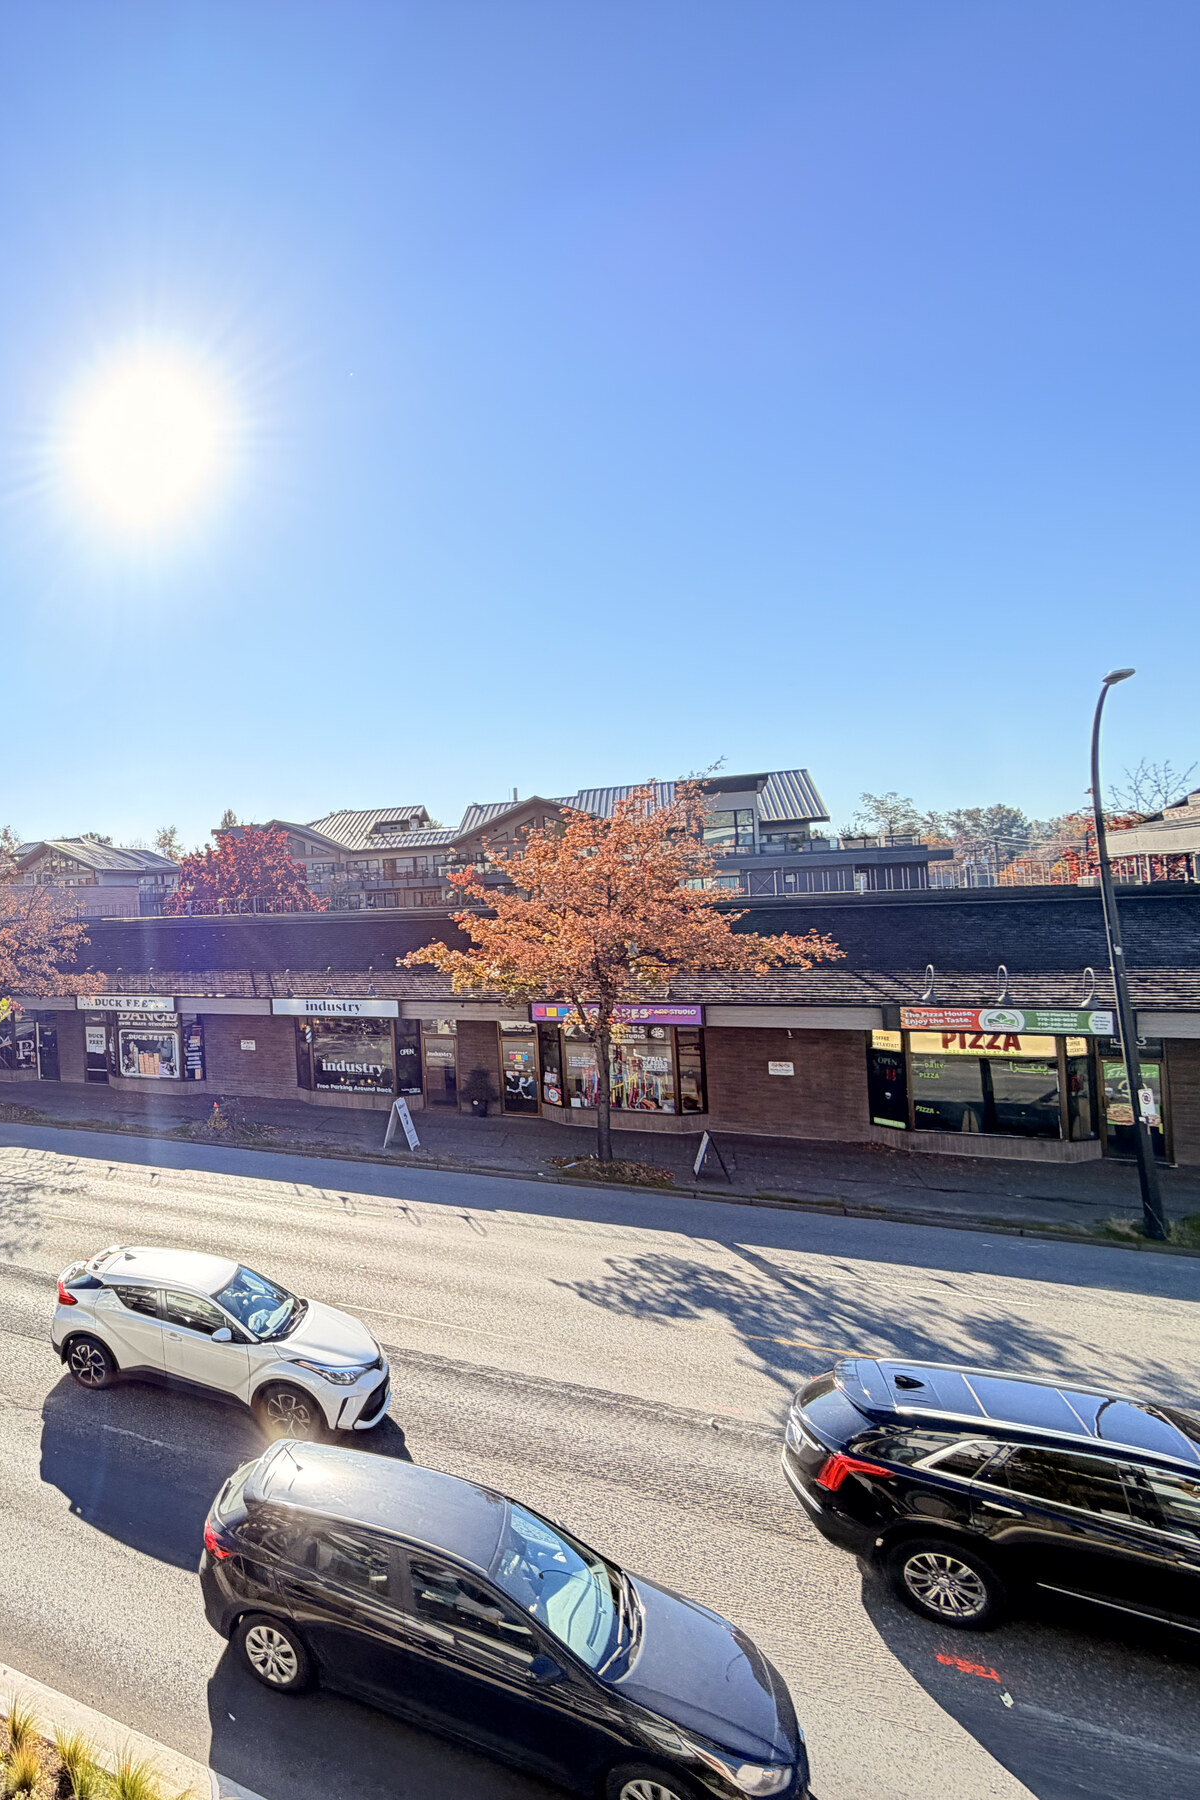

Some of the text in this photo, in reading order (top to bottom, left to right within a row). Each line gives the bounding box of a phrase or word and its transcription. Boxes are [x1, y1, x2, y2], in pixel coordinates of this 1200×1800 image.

[305, 1000, 362, 1015] industry
[669, 1008, 697, 1016] STUDIO
[117, 1012, 178, 1021] DANCE
[944, 1010, 976, 1018] House.
[904, 1018, 929, 1026] Enjoy
[942, 1032, 1022, 1051] PIZZA
[400, 1048, 415, 1056] OPEN
[877, 1056, 898, 1066] OPEN
[321, 1058, 385, 1077] industry
[330, 1084, 353, 1092] Parking
[915, 1105, 935, 1114] PIZZA
